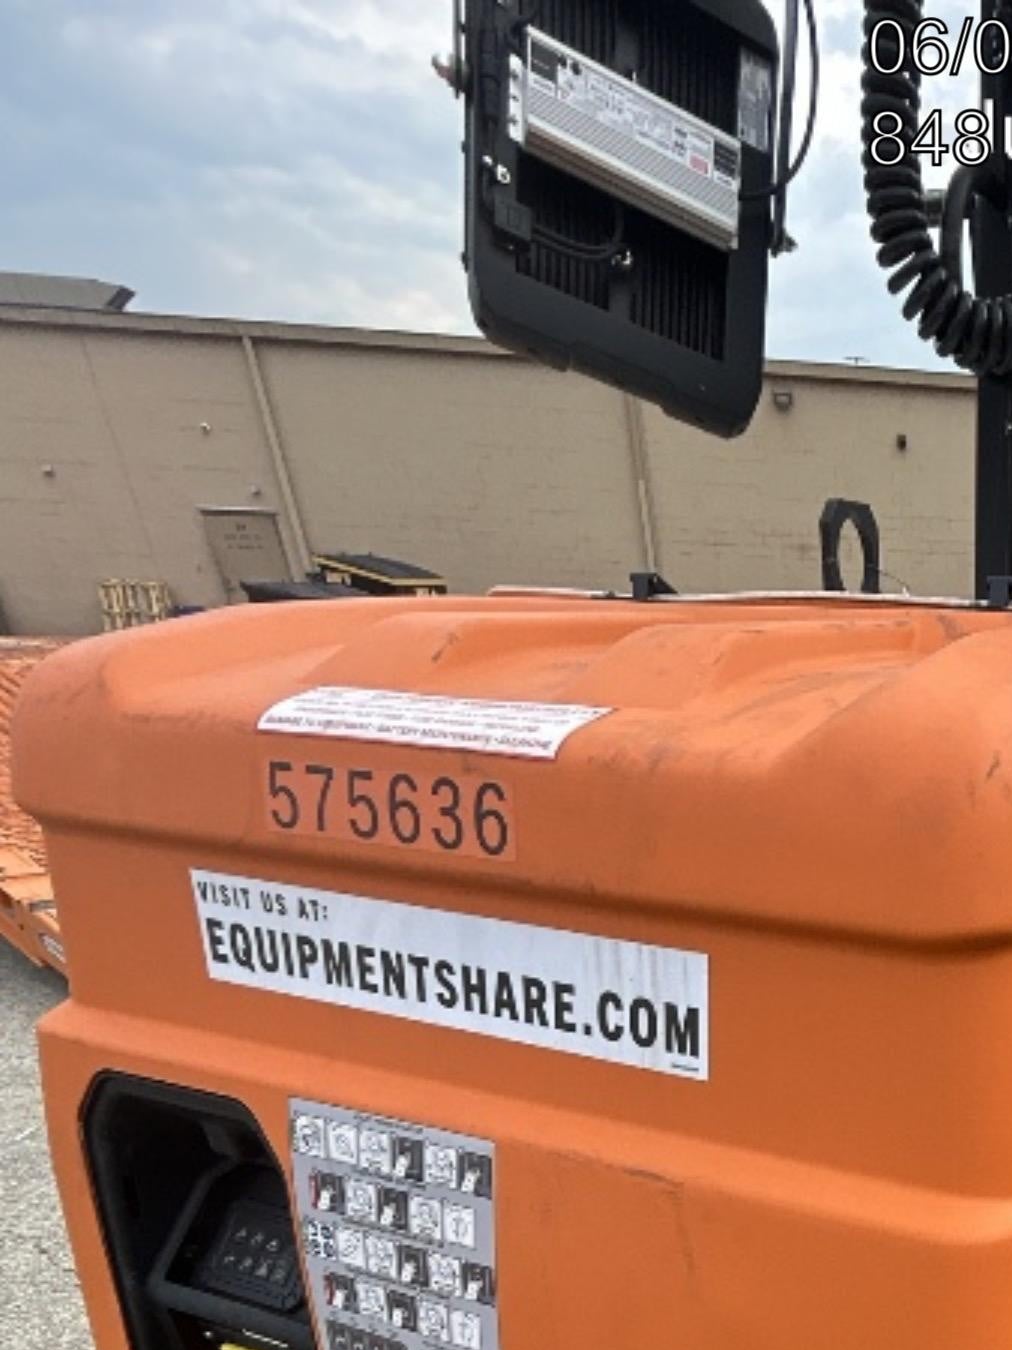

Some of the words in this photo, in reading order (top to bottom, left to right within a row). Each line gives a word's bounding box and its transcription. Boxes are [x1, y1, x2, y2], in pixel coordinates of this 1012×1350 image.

[268, 761, 509, 856] 575636
[197, 881, 251, 910] VISIT
[260, 890, 288, 916] US
[298, 897, 330, 922] AT:
[205, 917, 701, 1058] EQUIPMENTSHARE.COM
